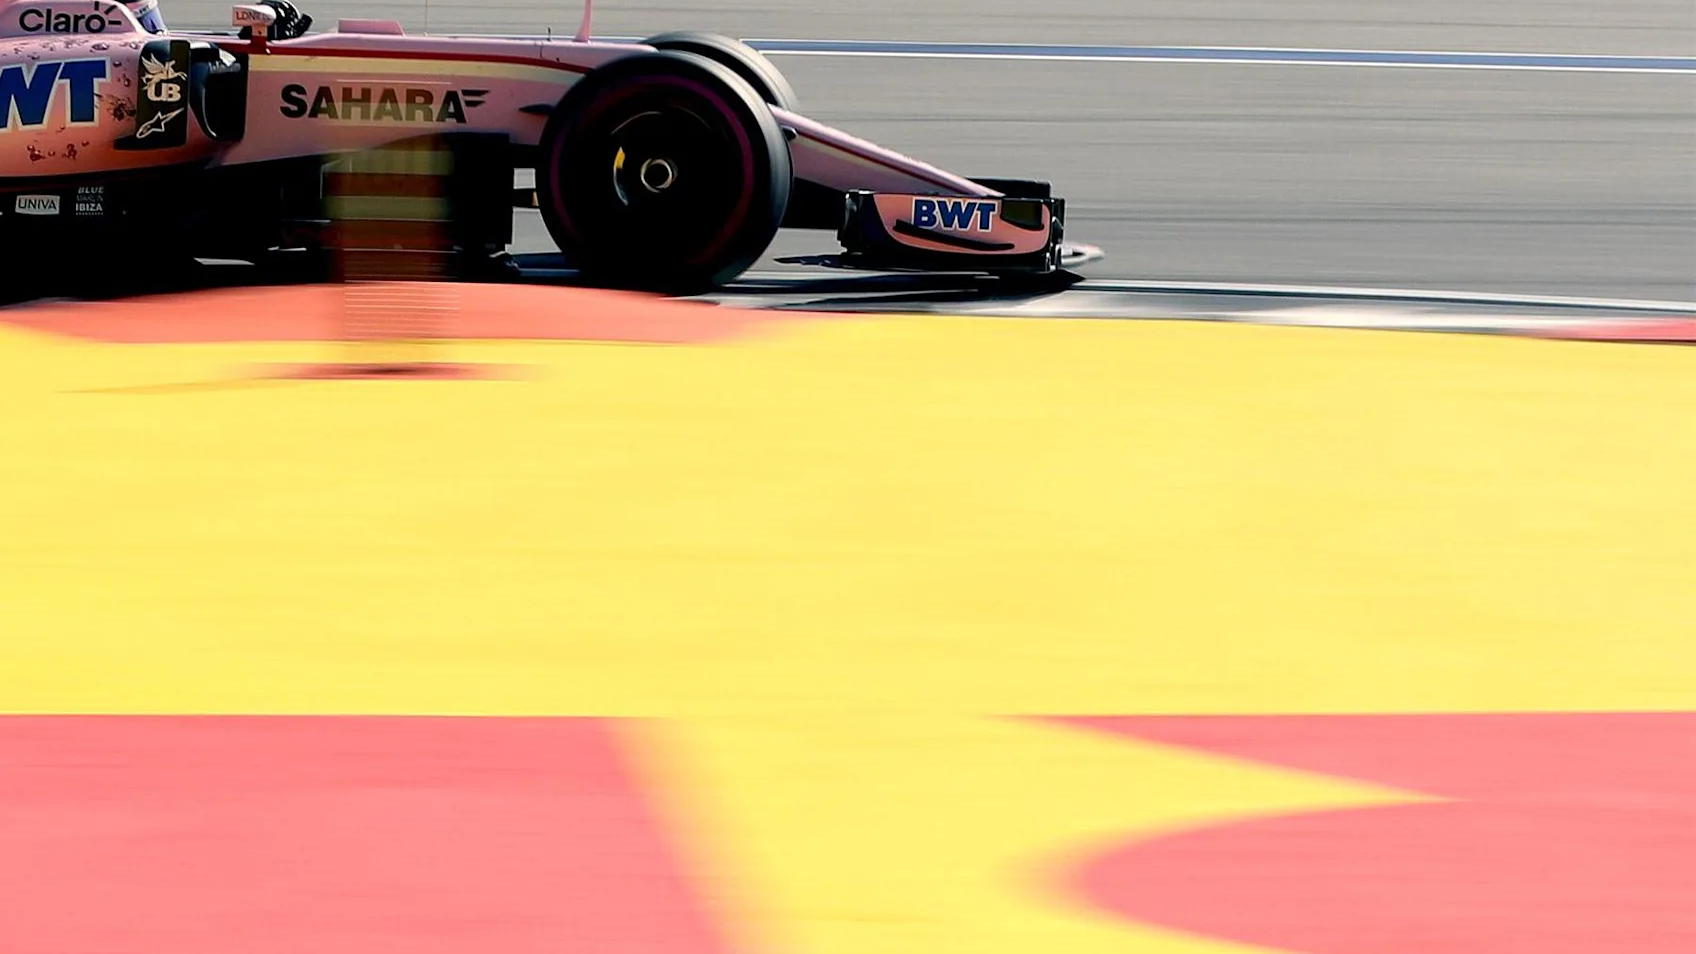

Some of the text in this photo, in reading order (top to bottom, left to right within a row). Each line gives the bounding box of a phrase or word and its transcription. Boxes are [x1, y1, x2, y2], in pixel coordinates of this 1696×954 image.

[19, 7, 106, 33] Claro
[279, 84, 468, 124] SAHARA
[18, 198, 57, 210] UNIVA
[75, 203, 103, 211] IBIZA
[912, 197, 997, 232] BWT
